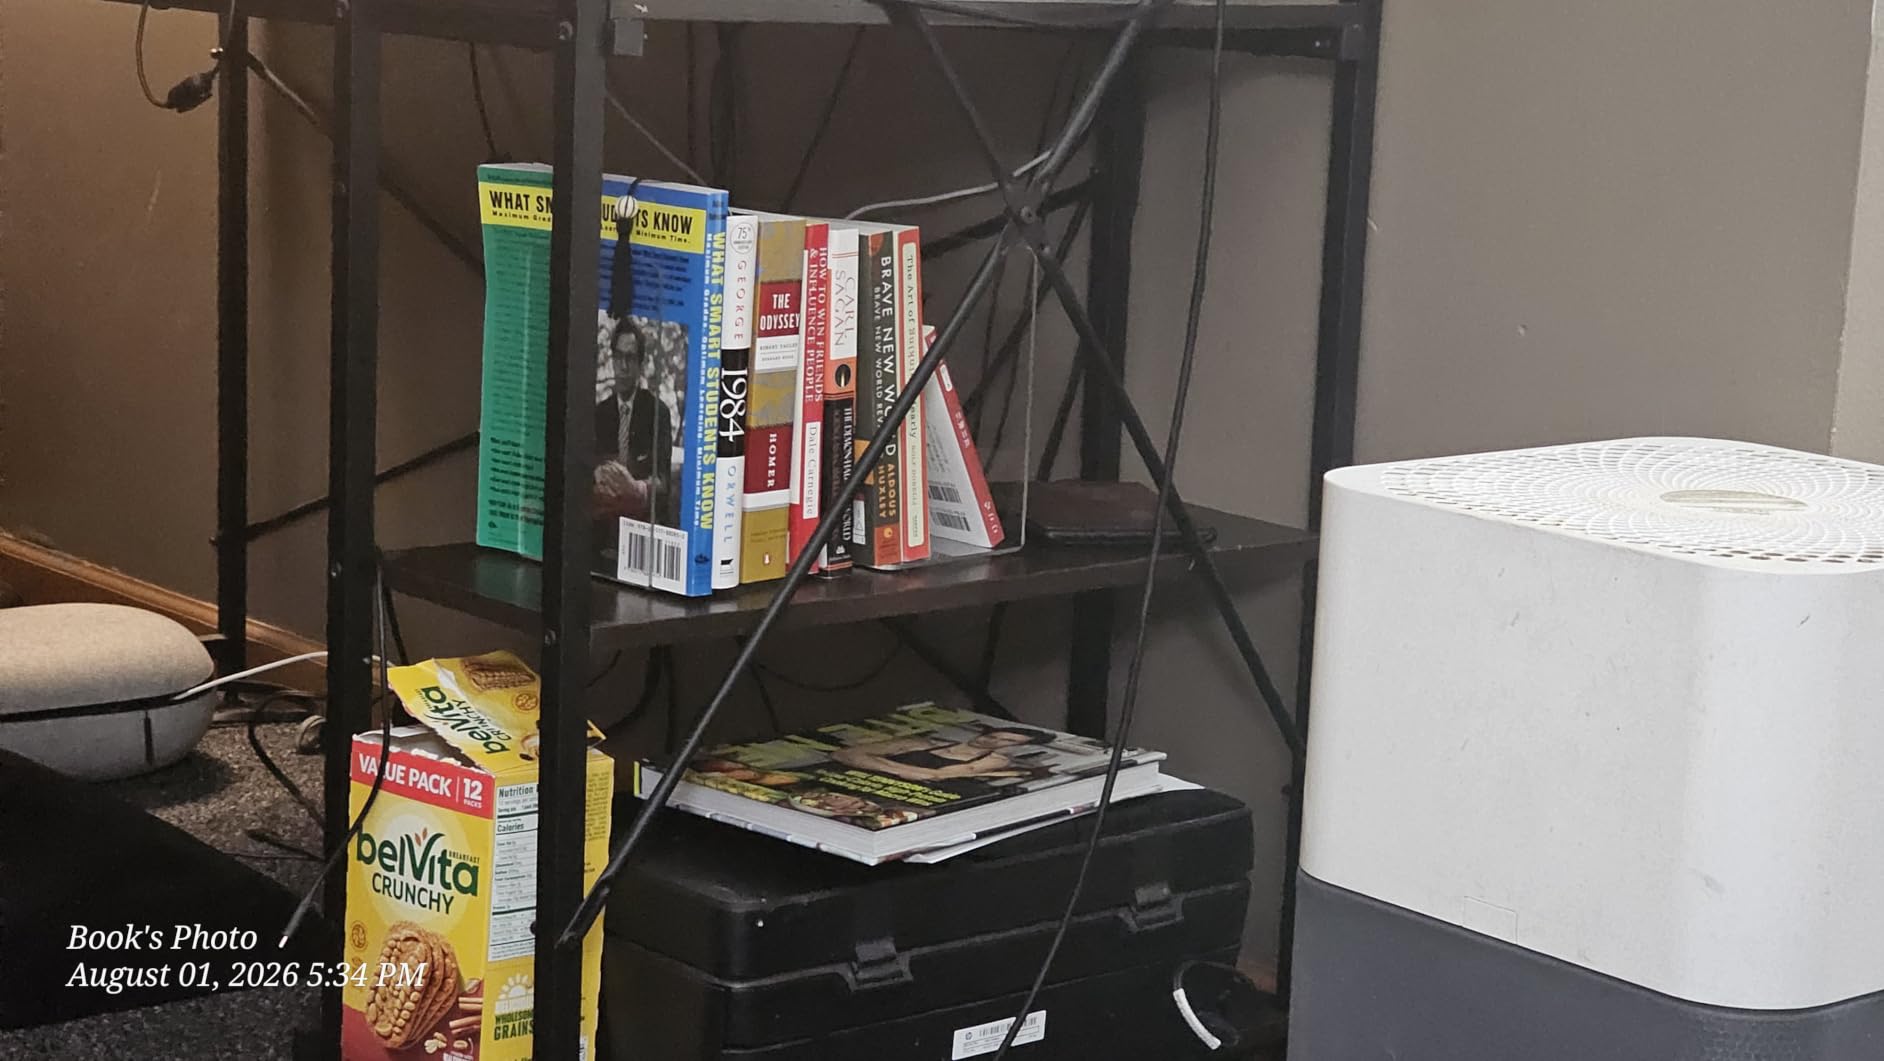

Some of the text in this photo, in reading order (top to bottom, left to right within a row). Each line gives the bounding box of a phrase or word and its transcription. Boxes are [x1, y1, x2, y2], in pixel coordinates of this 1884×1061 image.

[489, 190, 530, 211] WHAT
[602, 203, 648, 228] UDTS
[653, 211, 693, 235] KNOW
[492, 210, 529, 219] Maximum
[636, 230, 666, 240] Minimum
[704, 233, 712, 284] Maximum
[711, 231, 726, 285] WHAT
[734, 260, 747, 339] GEORGE
[772, 293, 791, 309] THE
[834, 270, 847, 346] SAGAN
[845, 277, 855, 338] CARL
[881, 256, 893, 317] BRAVE
[707, 293, 723, 360] SMART
[760, 313, 800, 331] ODYSSEY
[805, 248, 818, 402] & INFLUENCE PEOPLE
[815, 247, 827, 402] HOW TO WIN FRIENDS
[908, 310, 915, 322] of
[882, 327, 894, 374] NEW
[875, 358, 883, 398] WORLD
[703, 367, 720, 465] STUDENTS
[719, 368, 748, 442] 1984
[909, 403, 918, 438] early
[767, 433, 777, 487] HOMER
[806, 427, 817, 515] Dale Carnegie
[700, 472, 715, 529] KNOW
[723, 465, 737, 543] ORWELL
[877, 465, 887, 518] HUXLEY
[887, 463, 896, 517] ALDOUS
[842, 507, 852, 540] ORLD
[359, 753, 483, 801] VAUE PACK 12
[499, 786, 533, 798] Nutrition
[463, 799, 482, 809] PACKS
[497, 823, 524, 832] Calories
[449, 851, 480, 864] BREAKFAST
[372, 872, 454, 915] CRUNCHY
[494, 1020, 534, 1041] GRAINS
[495, 1010, 533, 1024] WHOLESOM
